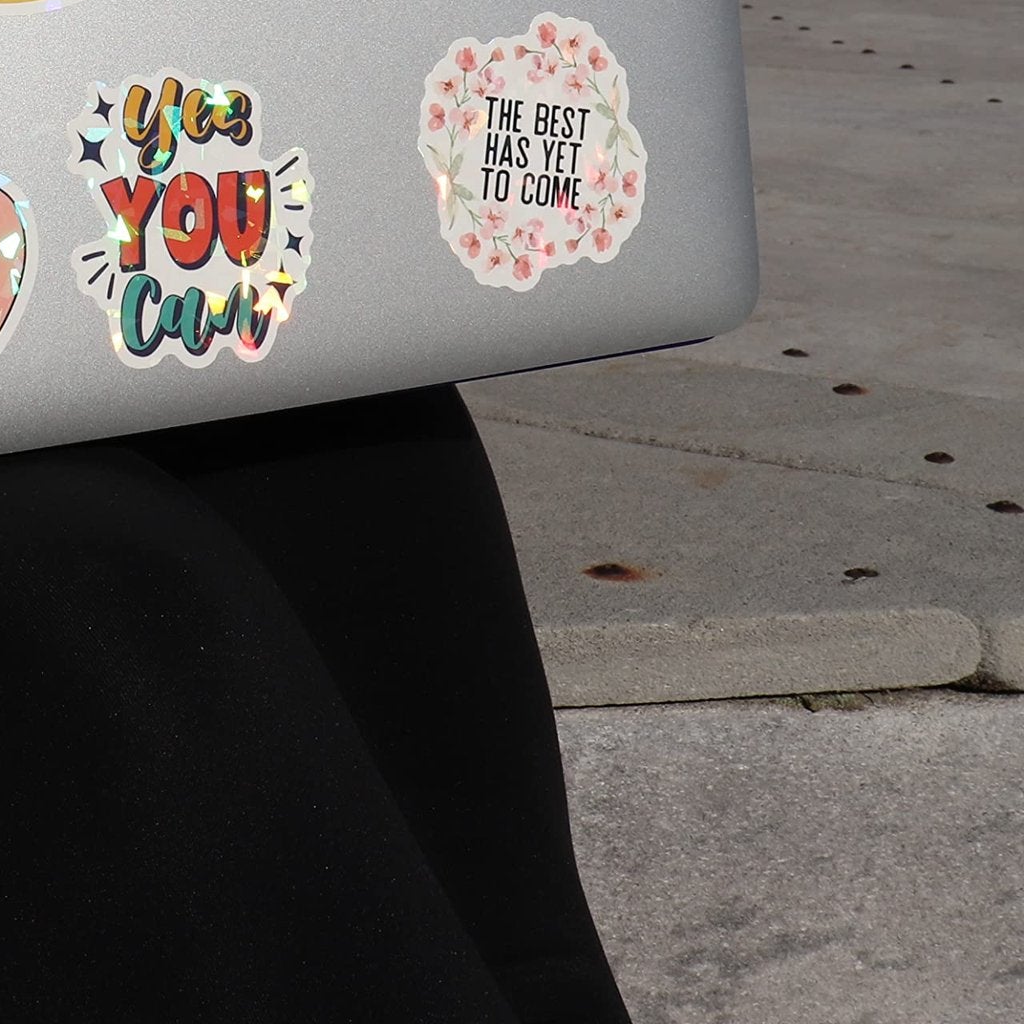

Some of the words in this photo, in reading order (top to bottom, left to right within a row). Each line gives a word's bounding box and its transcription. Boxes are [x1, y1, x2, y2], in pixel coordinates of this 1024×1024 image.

[485, 96, 524, 133] THE
[534, 103, 591, 140] BEST
[485, 132, 530, 169] HAS
[543, 139, 582, 174] YET
[481, 167, 510, 202] TO
[521, 173, 582, 210] COME
[100, 169, 271, 273] YOU
[120, 273, 271, 357] Can
